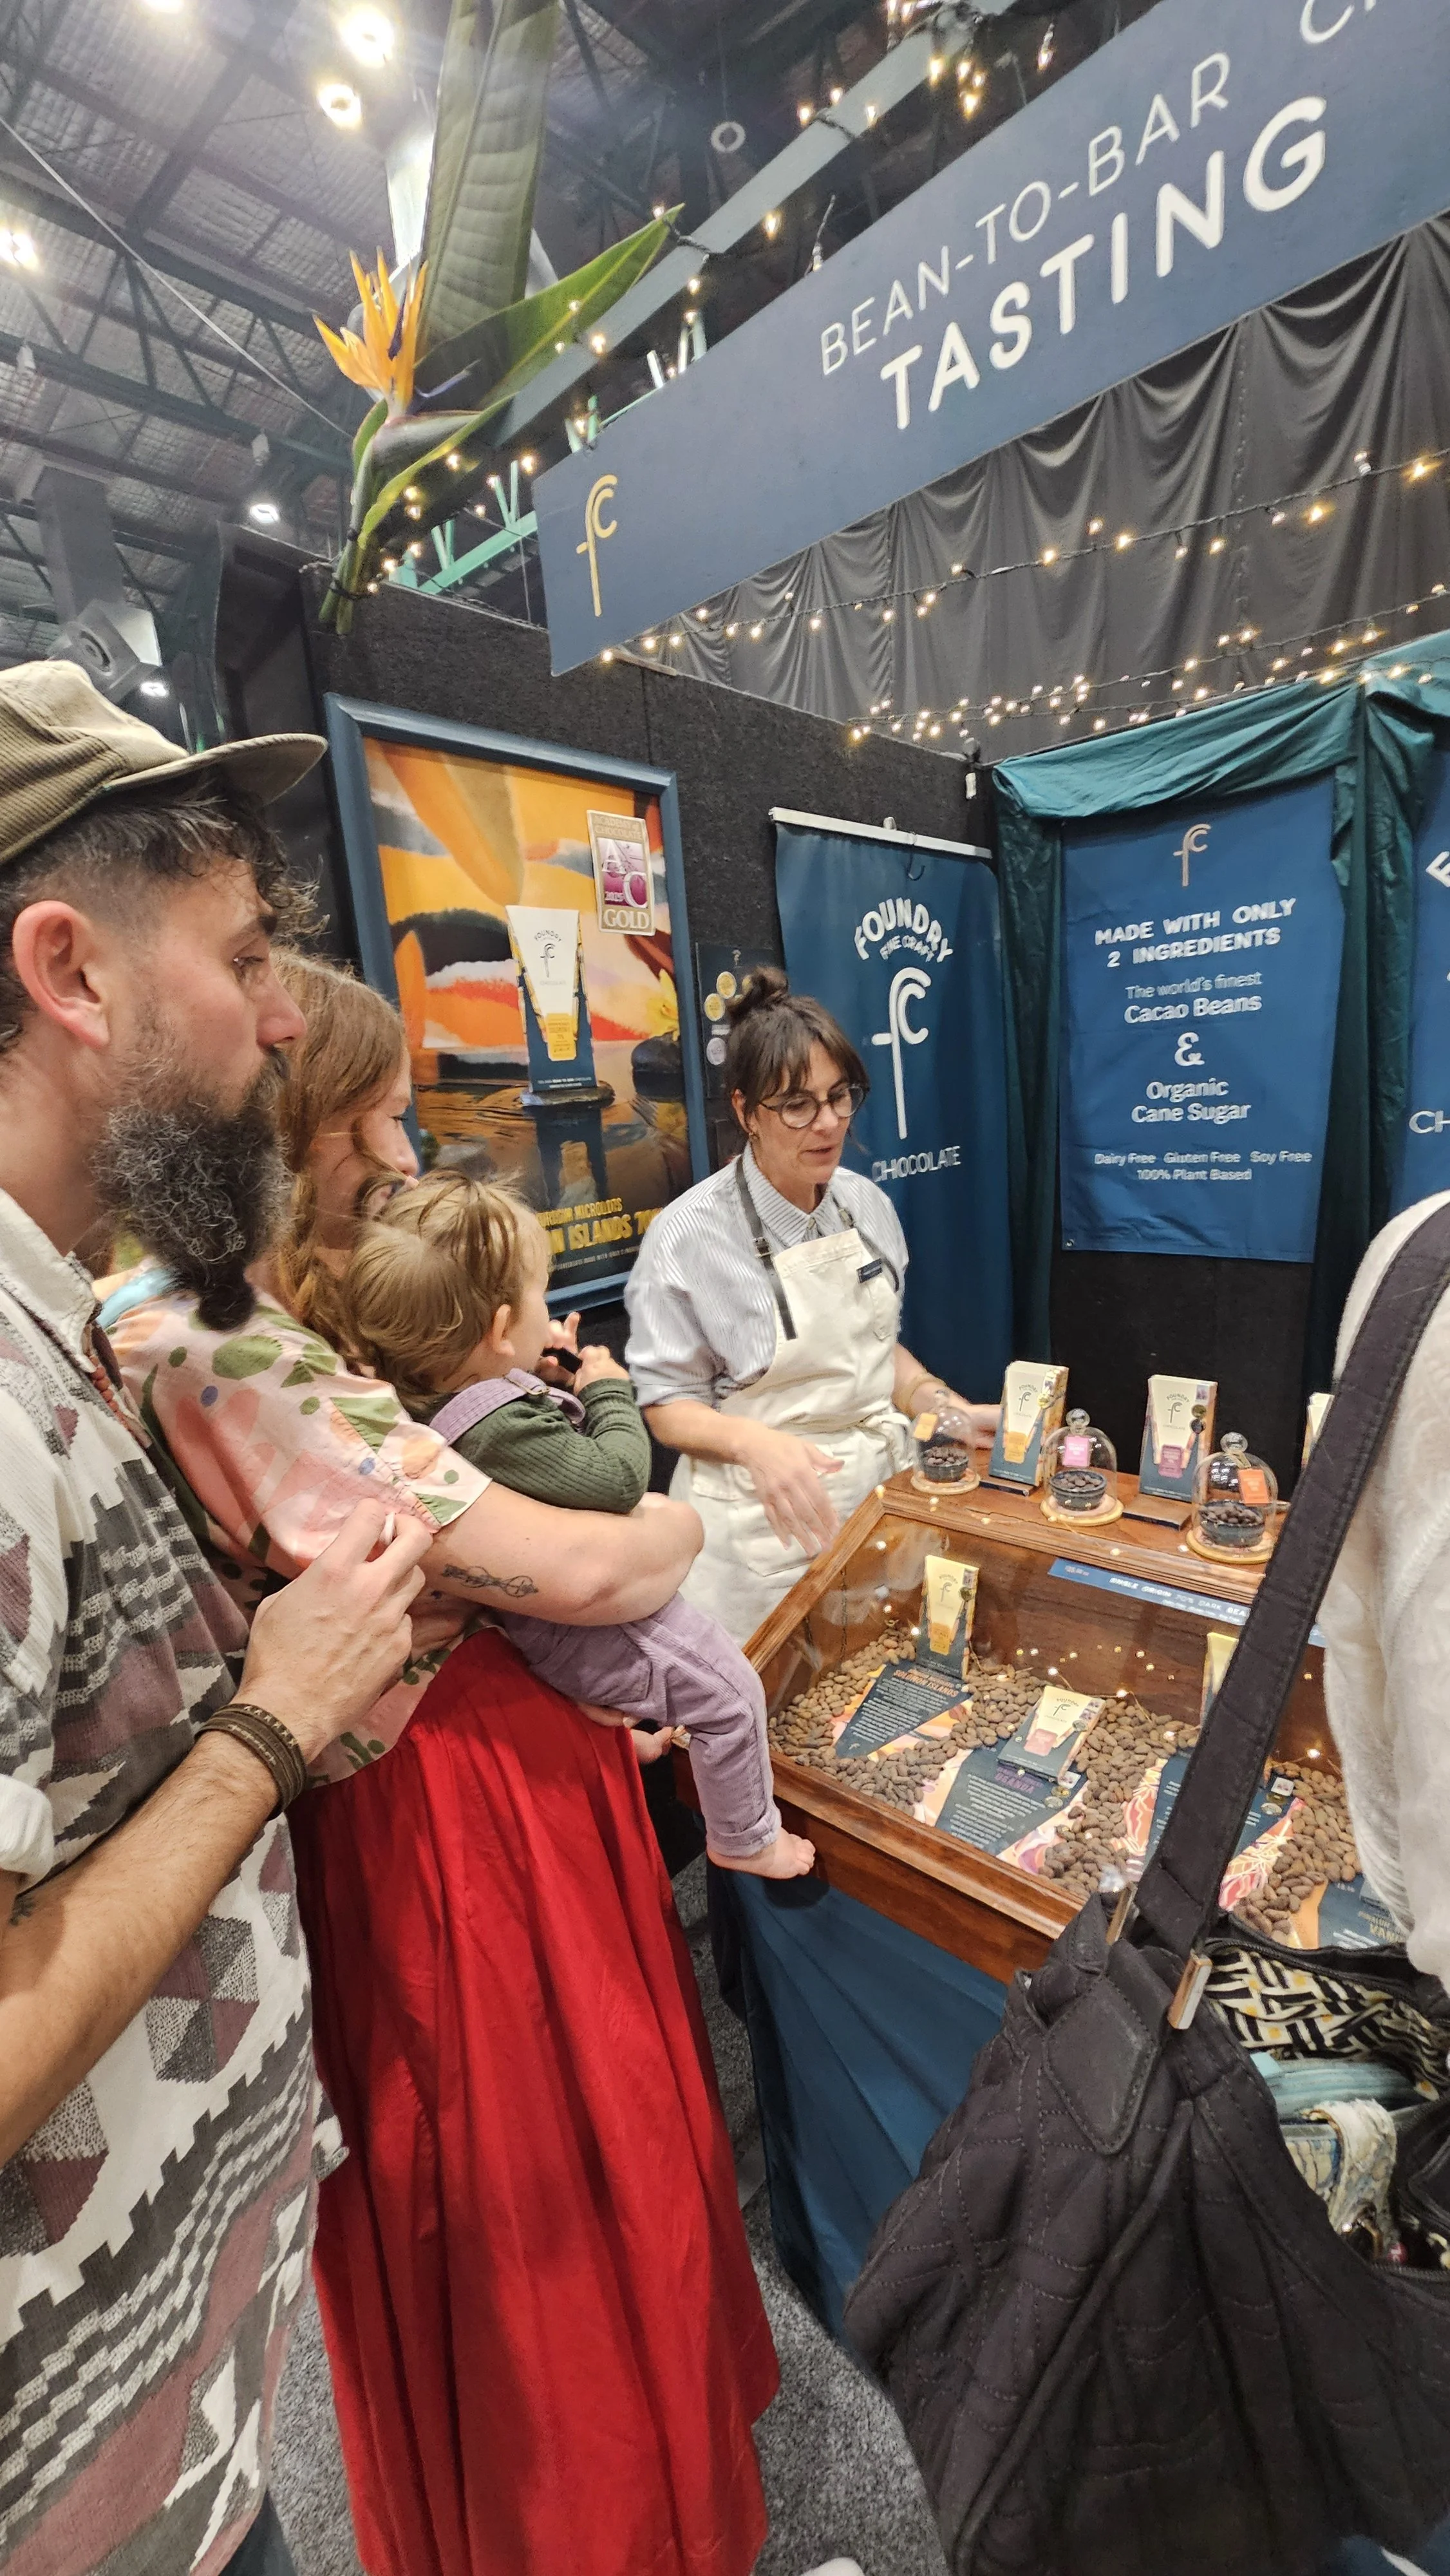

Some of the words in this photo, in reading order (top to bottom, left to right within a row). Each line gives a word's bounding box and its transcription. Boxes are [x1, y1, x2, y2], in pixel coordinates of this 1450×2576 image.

[820, 53, 1230, 375] BEAN-TO-BAR
[880, 96, 1326, 430] TASTING
[603, 909, 650, 929] GOLD
[854, 897, 954, 963] FOUNDRY
[1095, 921, 1154, 945] MADE
[1163, 911, 1221, 934] WITH
[1232, 898, 1296, 923] ONLY
[1107, 951, 1121, 968] 2
[1133, 927, 1281, 964] INGREDIENTS
[1125, 985, 1155, 999] The
[1157, 976, 1212, 996] world's
[1215, 971, 1263, 989] finest
[1124, 1004, 1189, 1023] Cacao
[1193, 996, 1263, 1017] Beans
[1174, 1032, 1205, 1066] &
[1145, 1077, 1229, 1103] Organic
[1131, 1105, 1183, 1122] Cane
[1187, 1103, 1252, 1124] Sugar
[872, 1146, 961, 1182] CHOCOLATE
[1095, 1153, 1125, 1166] Dairy
[1127, 1153, 1156, 1164] Free
[1163, 1152, 1208, 1164] Gluten
[1210, 1151, 1241, 1162] Free
[1250, 1151, 1277, 1166] Soy
[1279, 1150, 1313, 1162] Free
[1136, 1170, 1171, 1180] 100%
[1172, 1170, 1207, 1180] Plant
[1210, 1168, 1252, 1180] Based
[568, 1214, 633, 1250] ISLANDS
[1109, 1577, 1139, 1590] SINGLE
[1141, 1586, 1172, 1597] ORIGIN
[1198, 1600, 1221, 1611] DARK
[1225, 1607, 1248, 1617] BEA
